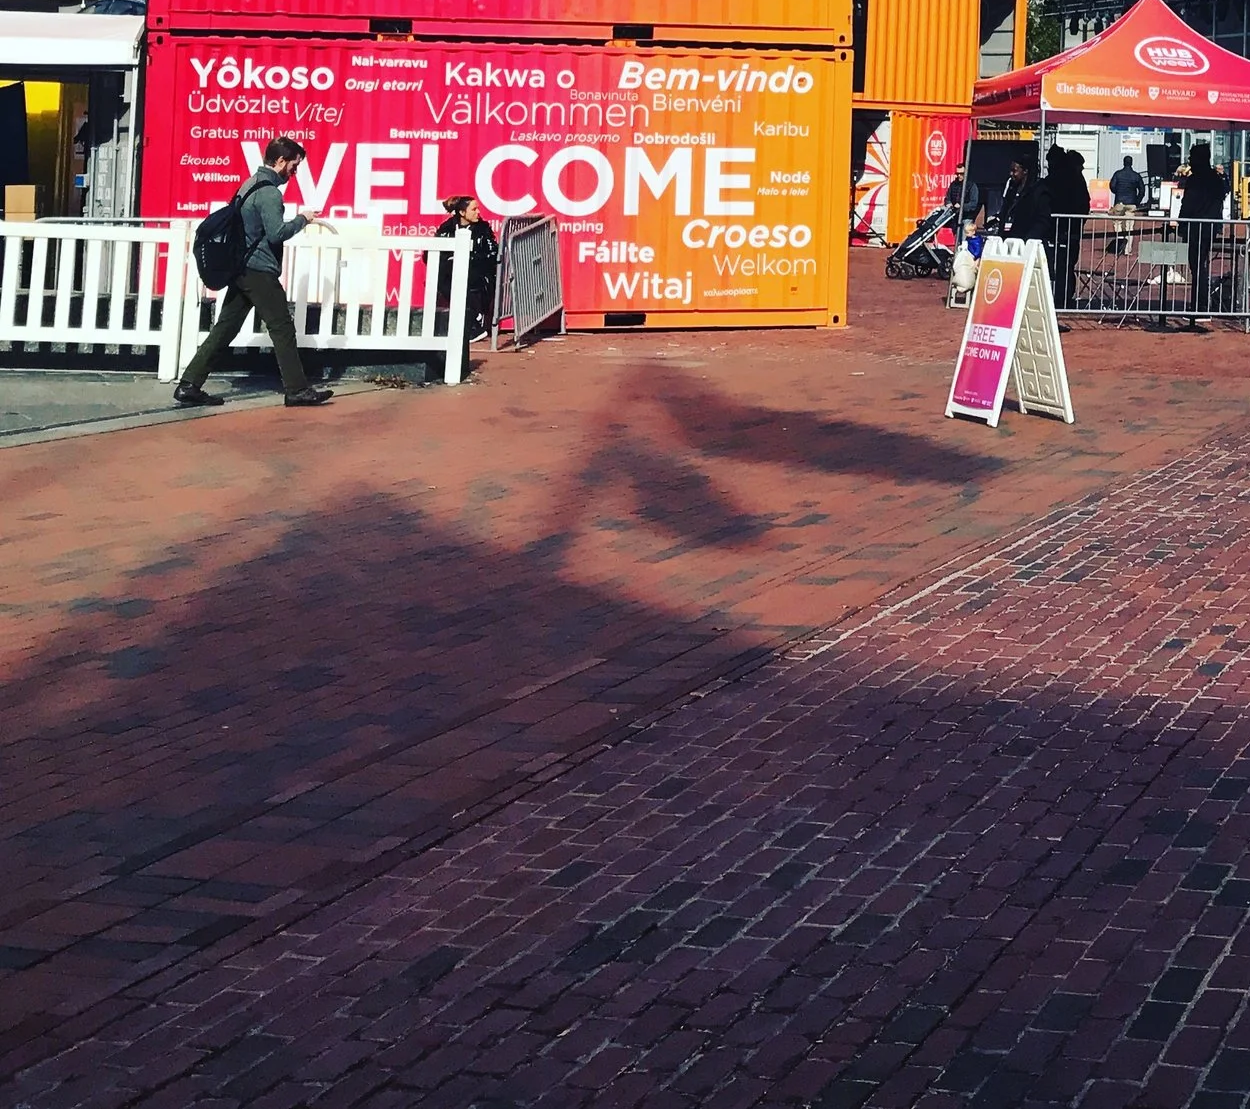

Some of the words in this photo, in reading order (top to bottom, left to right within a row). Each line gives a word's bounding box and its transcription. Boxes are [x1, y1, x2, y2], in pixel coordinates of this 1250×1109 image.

[1146, 47, 1193, 58] HUB
[189, 56, 335, 91] Yôkoso
[445, 62, 546, 89] Kakwa
[556, 69, 576, 89] o
[617, 60, 814, 94] Bem-vindo
[344, 78, 380, 92] Ongi
[382, 79, 423, 91] etorri
[1056, 82, 1073, 94] The
[1076, 83, 1111, 97] Boston
[1112, 85, 1140, 99] Globe
[188, 90, 291, 114] Üdvözlet
[569, 89, 639, 102] Bonavinuta
[652, 93, 742, 114] Bienvéni
[424, 91, 650, 128] Välkommen
[190, 126, 239, 139] Gratus
[243, 127, 275, 140] mihi
[279, 127, 316, 140] venis
[389, 128, 459, 141] Benvinguts
[510, 130, 562, 142] Laskavo
[564, 131, 621, 144] prosymo
[633, 131, 716, 145] Dobrodošli
[753, 121, 810, 137] Karibu
[240, 141, 756, 218] WELCOME
[681, 219, 813, 249] Croeso
[578, 240, 656, 264] Fáilte
[712, 253, 817, 276] Welkom
[603, 271, 693, 305] Witaj
[971, 325, 998, 343] FREE
[979, 348, 991, 361] ON
[991, 349, 1001, 362] IN
